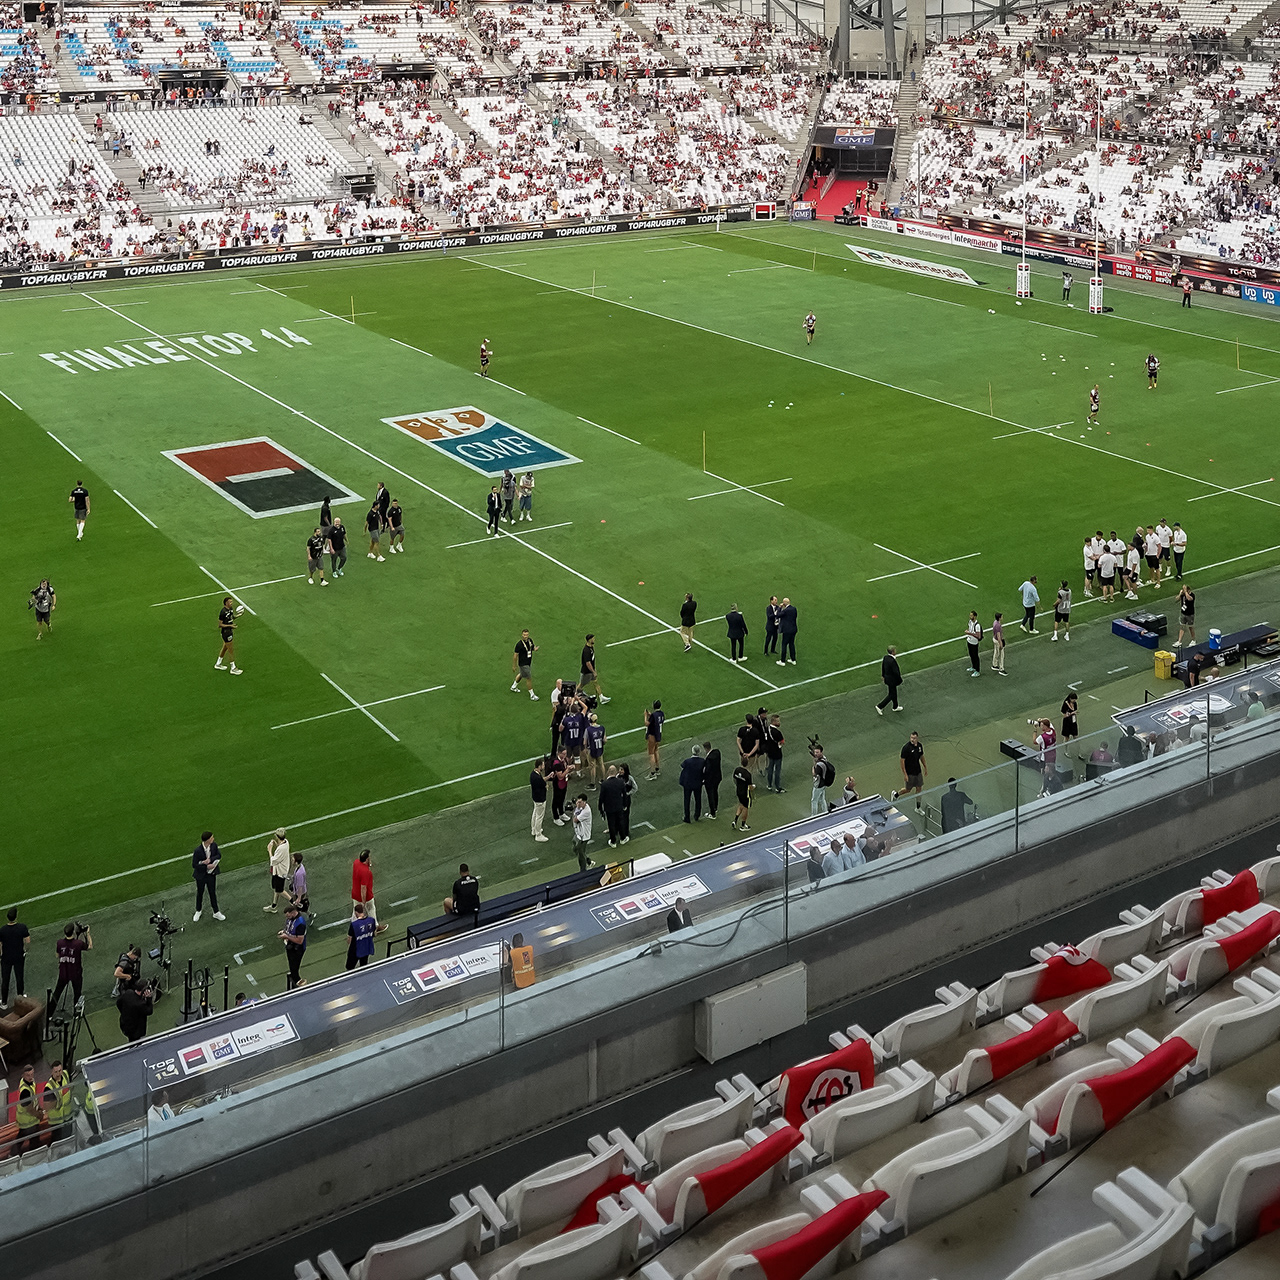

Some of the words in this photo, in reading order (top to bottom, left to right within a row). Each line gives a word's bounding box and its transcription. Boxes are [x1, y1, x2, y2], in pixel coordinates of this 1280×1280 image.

[555, 224, 617, 237] TOP14RUGBY.FR
[628, 217, 686, 230] TOP14RUGBY.FR
[478, 230, 544, 244] TOP14RUGBY.FR
[311, 244, 384, 259] TOP14RUGBY.FR
[221, 252, 298, 268] TOP14RUGBY.FR
[124, 261, 205, 277] TOP14RUGBY.FR
[21, 269, 107, 286] TOP14RUGBY.FR
[39, 340, 191, 374] FINALE
[177, 332, 258, 357] TOP
[261, 326, 312, 348] 14
[456, 435, 534, 461] GMF
[446, 966, 463, 977] GMF
[214, 1046, 232, 1059] GMF
[149, 1058, 175, 1070] TOP
